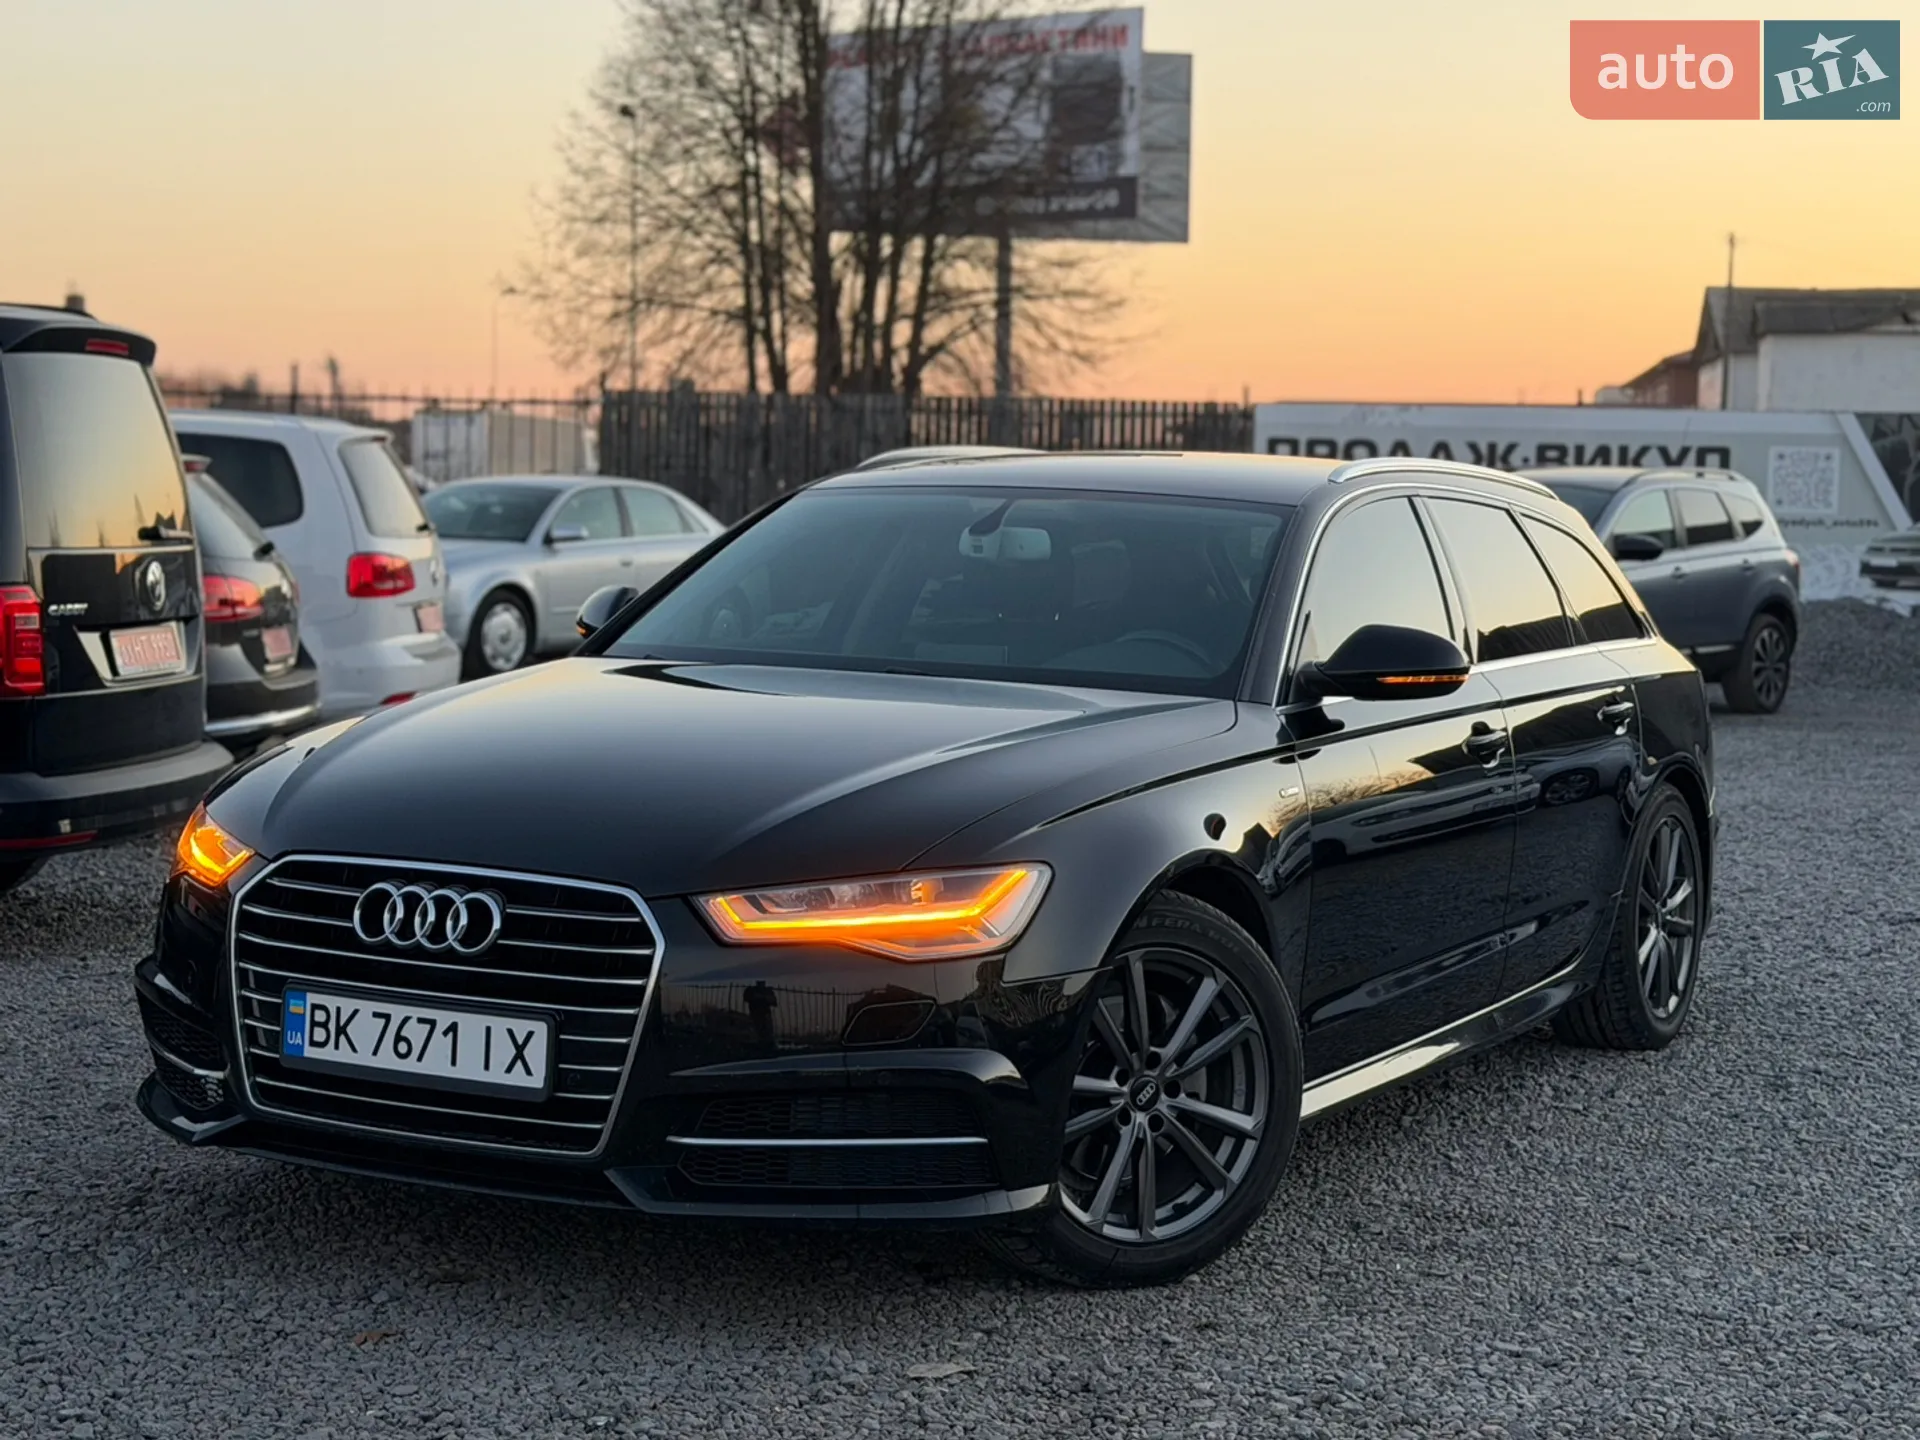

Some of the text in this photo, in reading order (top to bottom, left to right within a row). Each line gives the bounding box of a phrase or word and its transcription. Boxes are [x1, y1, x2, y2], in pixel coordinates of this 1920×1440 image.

[287, 1030, 302, 1046] UA
[308, 1002, 536, 1077] BK 7671 IX
